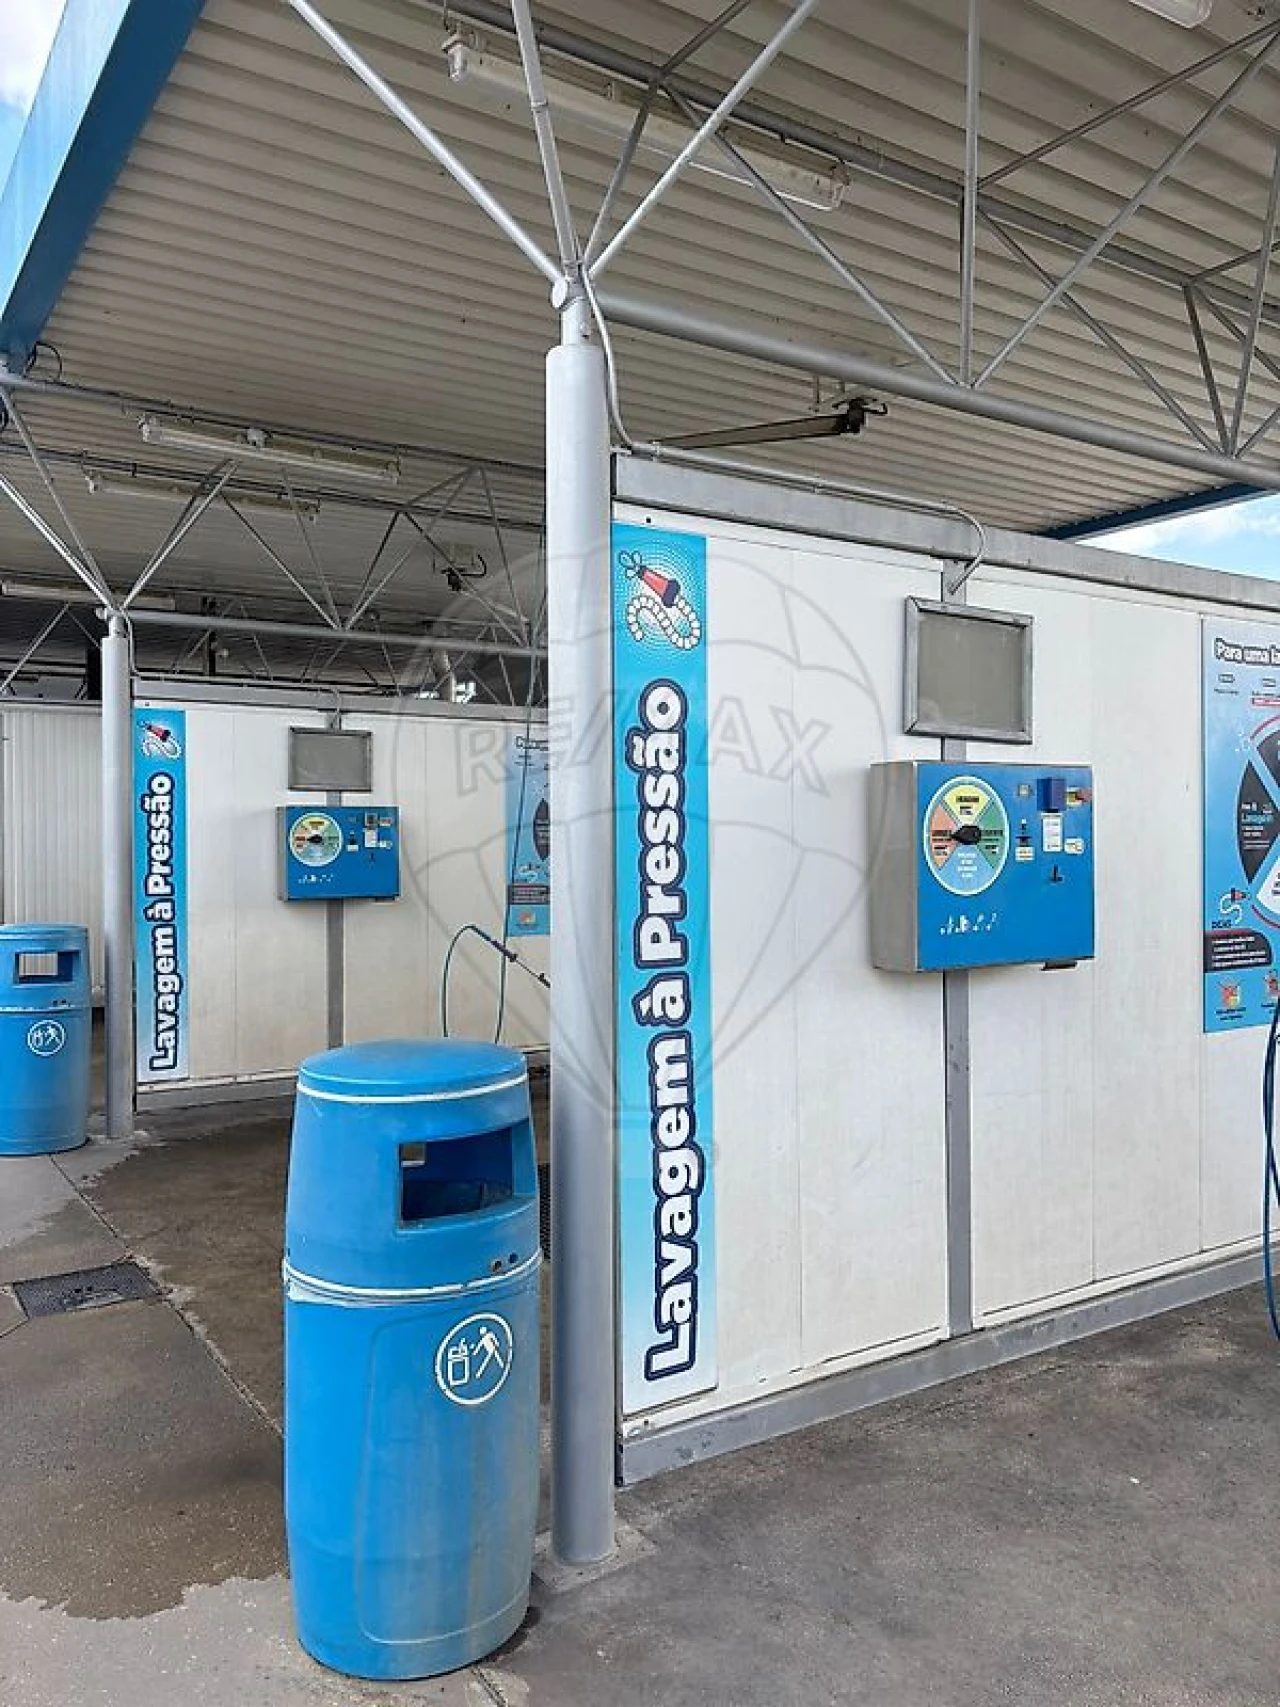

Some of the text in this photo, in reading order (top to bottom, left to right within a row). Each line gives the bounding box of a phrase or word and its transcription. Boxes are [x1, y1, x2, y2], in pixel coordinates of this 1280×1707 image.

[1214, 638, 1242, 663] Para
[141, 772, 175, 896] Pressão
[625, 678, 688, 968] Pressão
[150, 923, 183, 1071] Lavagem
[645, 1030, 703, 1381] Lavagem
